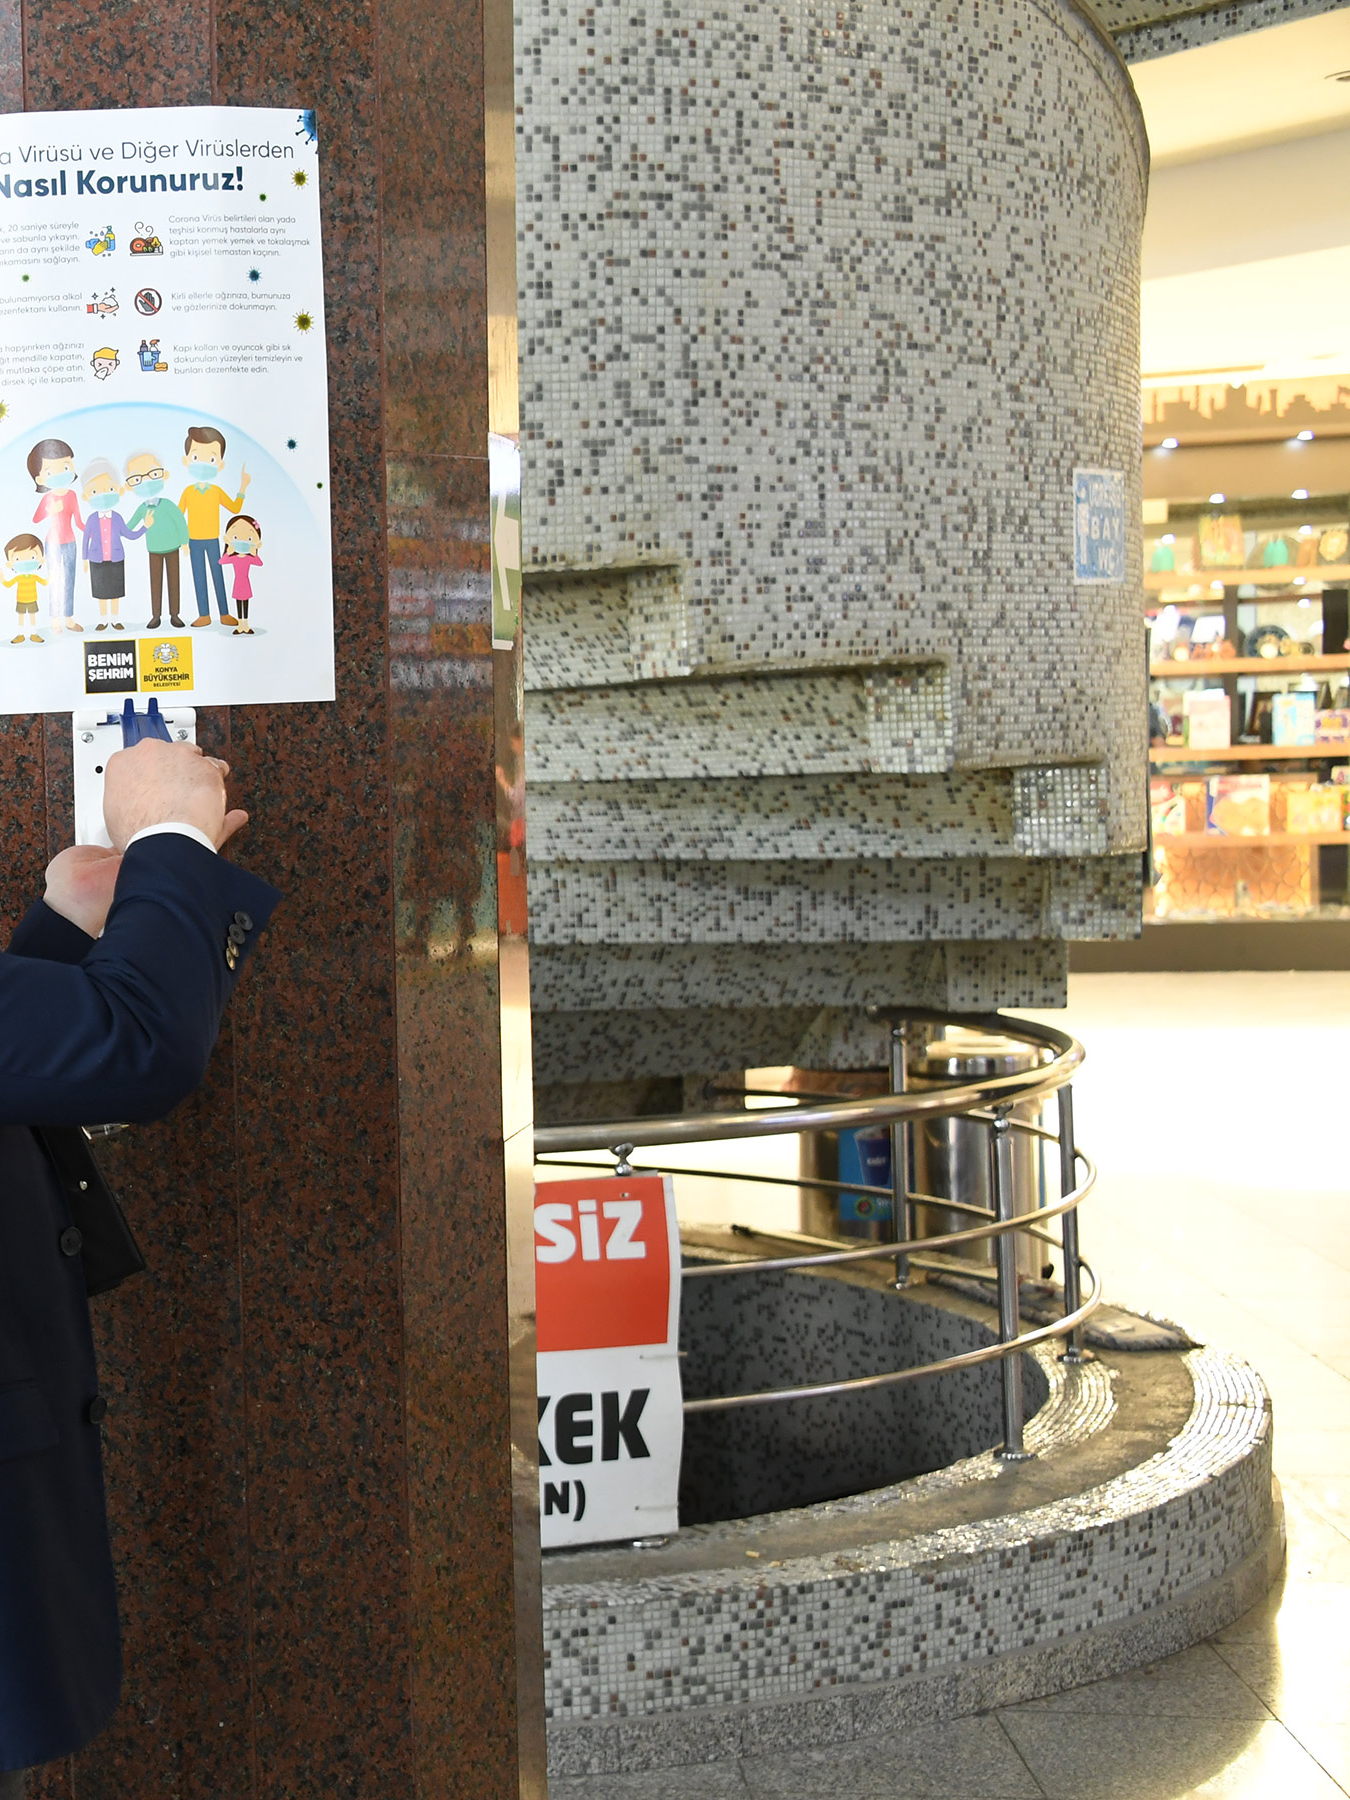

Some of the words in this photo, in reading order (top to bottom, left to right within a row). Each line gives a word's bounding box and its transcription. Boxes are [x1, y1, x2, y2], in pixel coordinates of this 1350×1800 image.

[19, 144, 82, 164] Virüsü
[89, 146, 114, 160] ve
[122, 141, 178, 163] Diğer
[185, 138, 294, 159] Virüslerden
[77, 166, 244, 195] Korunuruz!
[1091, 516, 1119, 540] BAY
[88, 653, 133, 667] BENİM
[88, 667, 133, 682] ŞEHRİM
[144, 672, 189, 682] BÜYÜKŞEHİR
